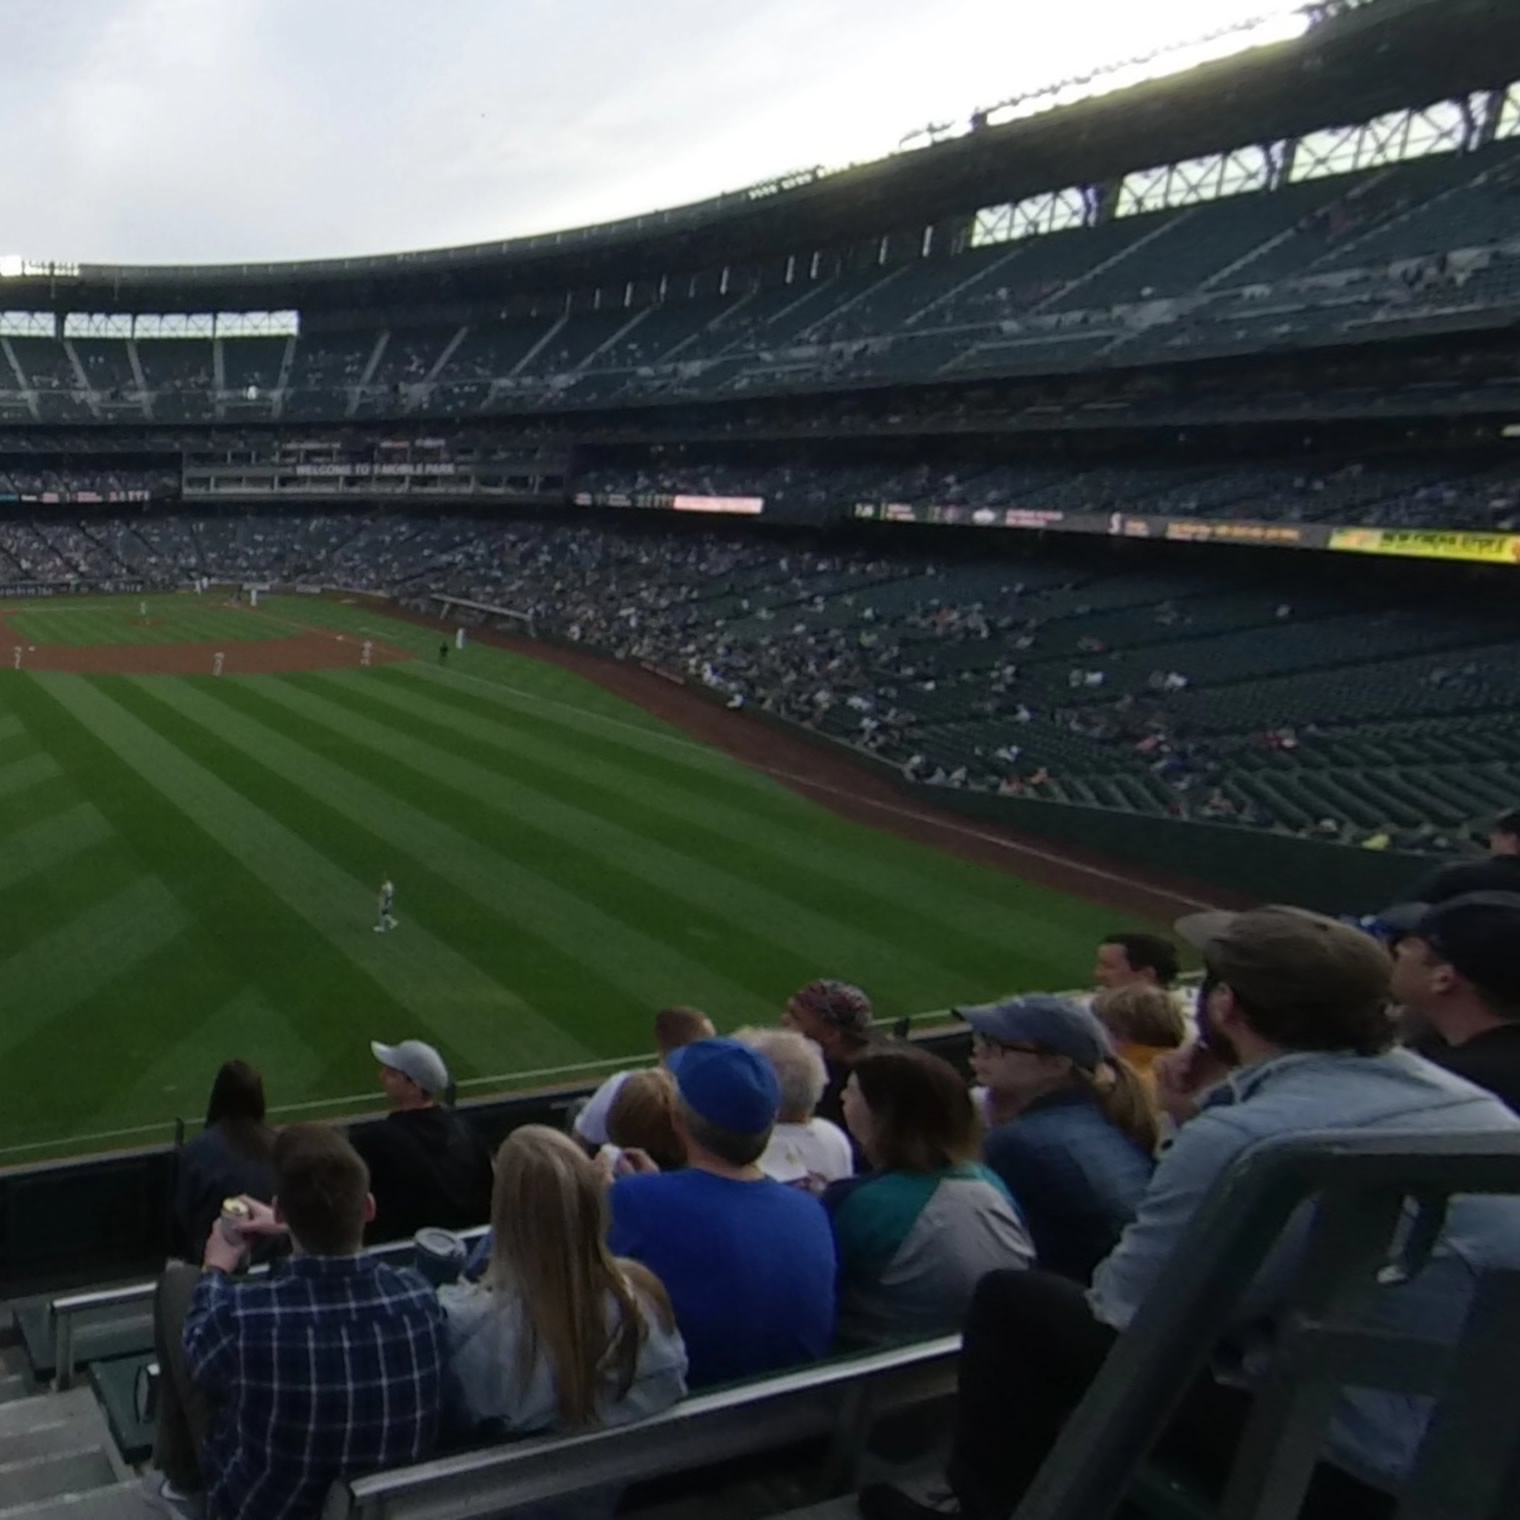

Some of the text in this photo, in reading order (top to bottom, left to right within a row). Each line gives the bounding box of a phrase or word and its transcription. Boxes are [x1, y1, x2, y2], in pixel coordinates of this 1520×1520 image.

[295, 464, 352, 476] WELCOME
[355, 463, 370, 475] TO
[424, 462, 455, 475] PARK
